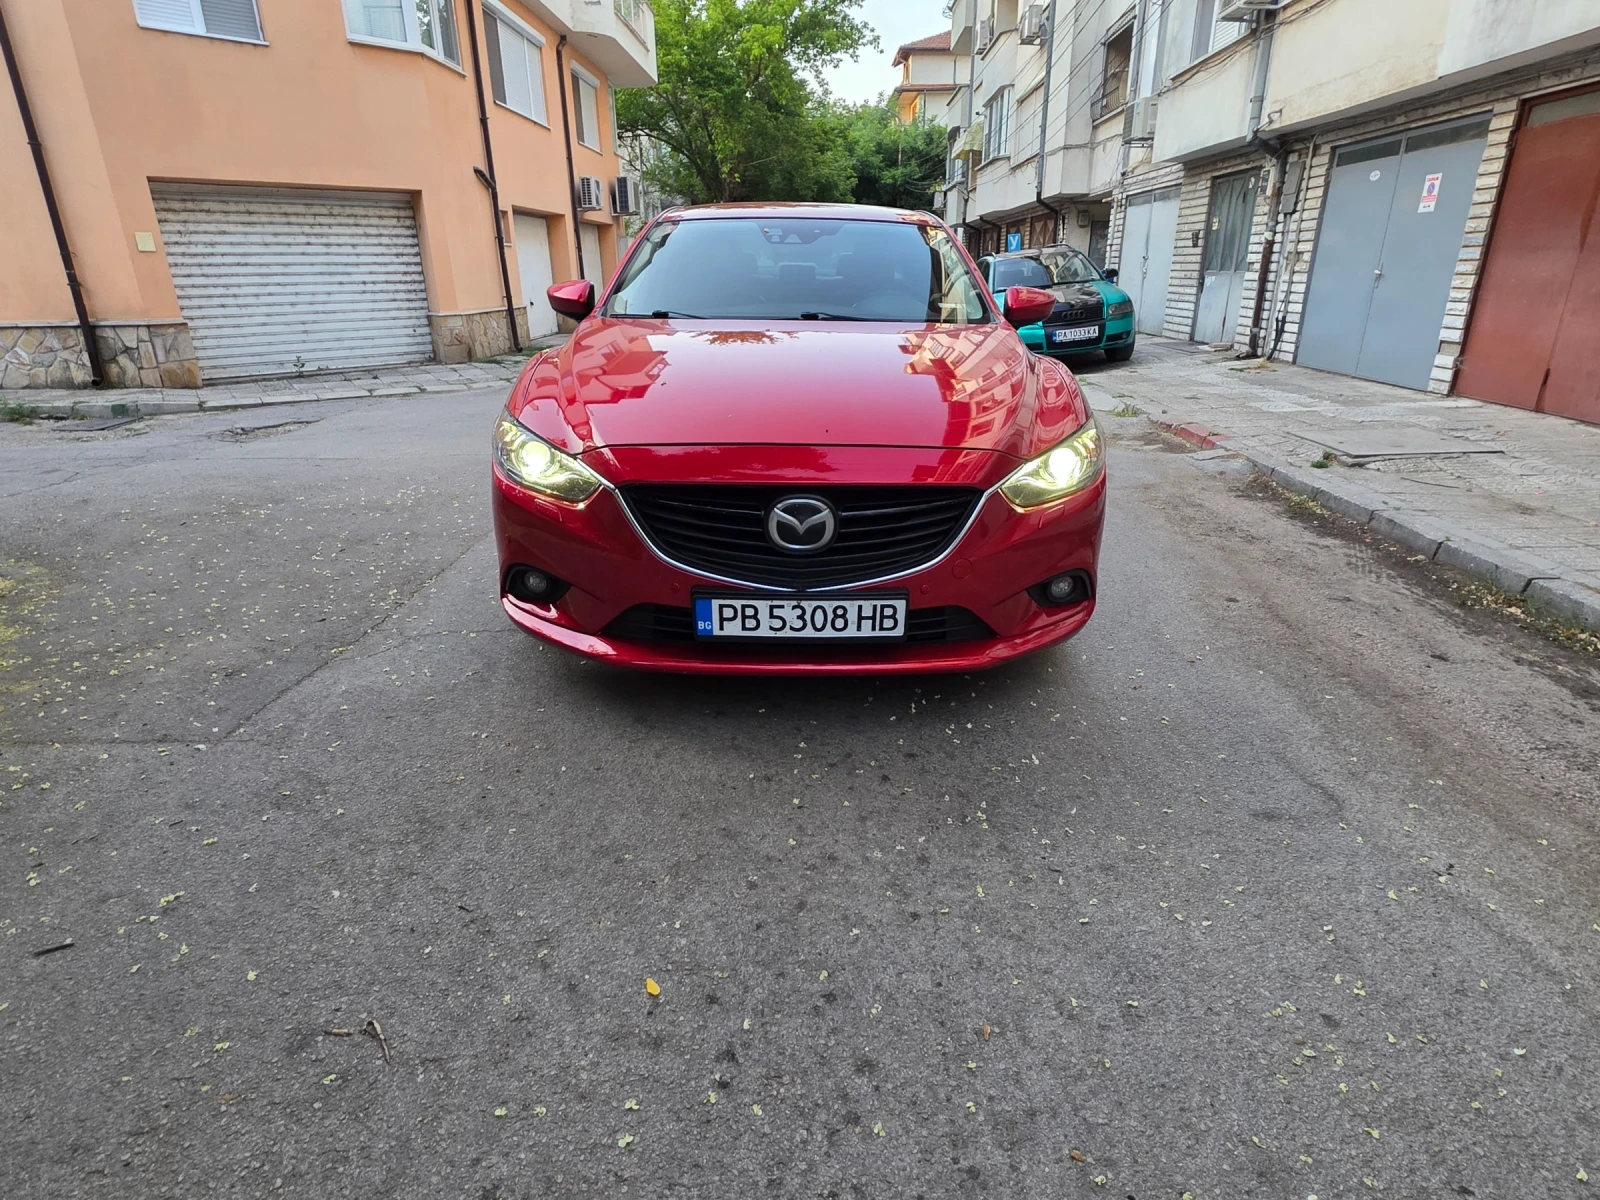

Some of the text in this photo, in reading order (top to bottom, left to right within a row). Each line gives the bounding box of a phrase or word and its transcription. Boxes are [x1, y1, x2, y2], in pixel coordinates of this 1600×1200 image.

[698, 603, 899, 633] BG PB 5308 HB
